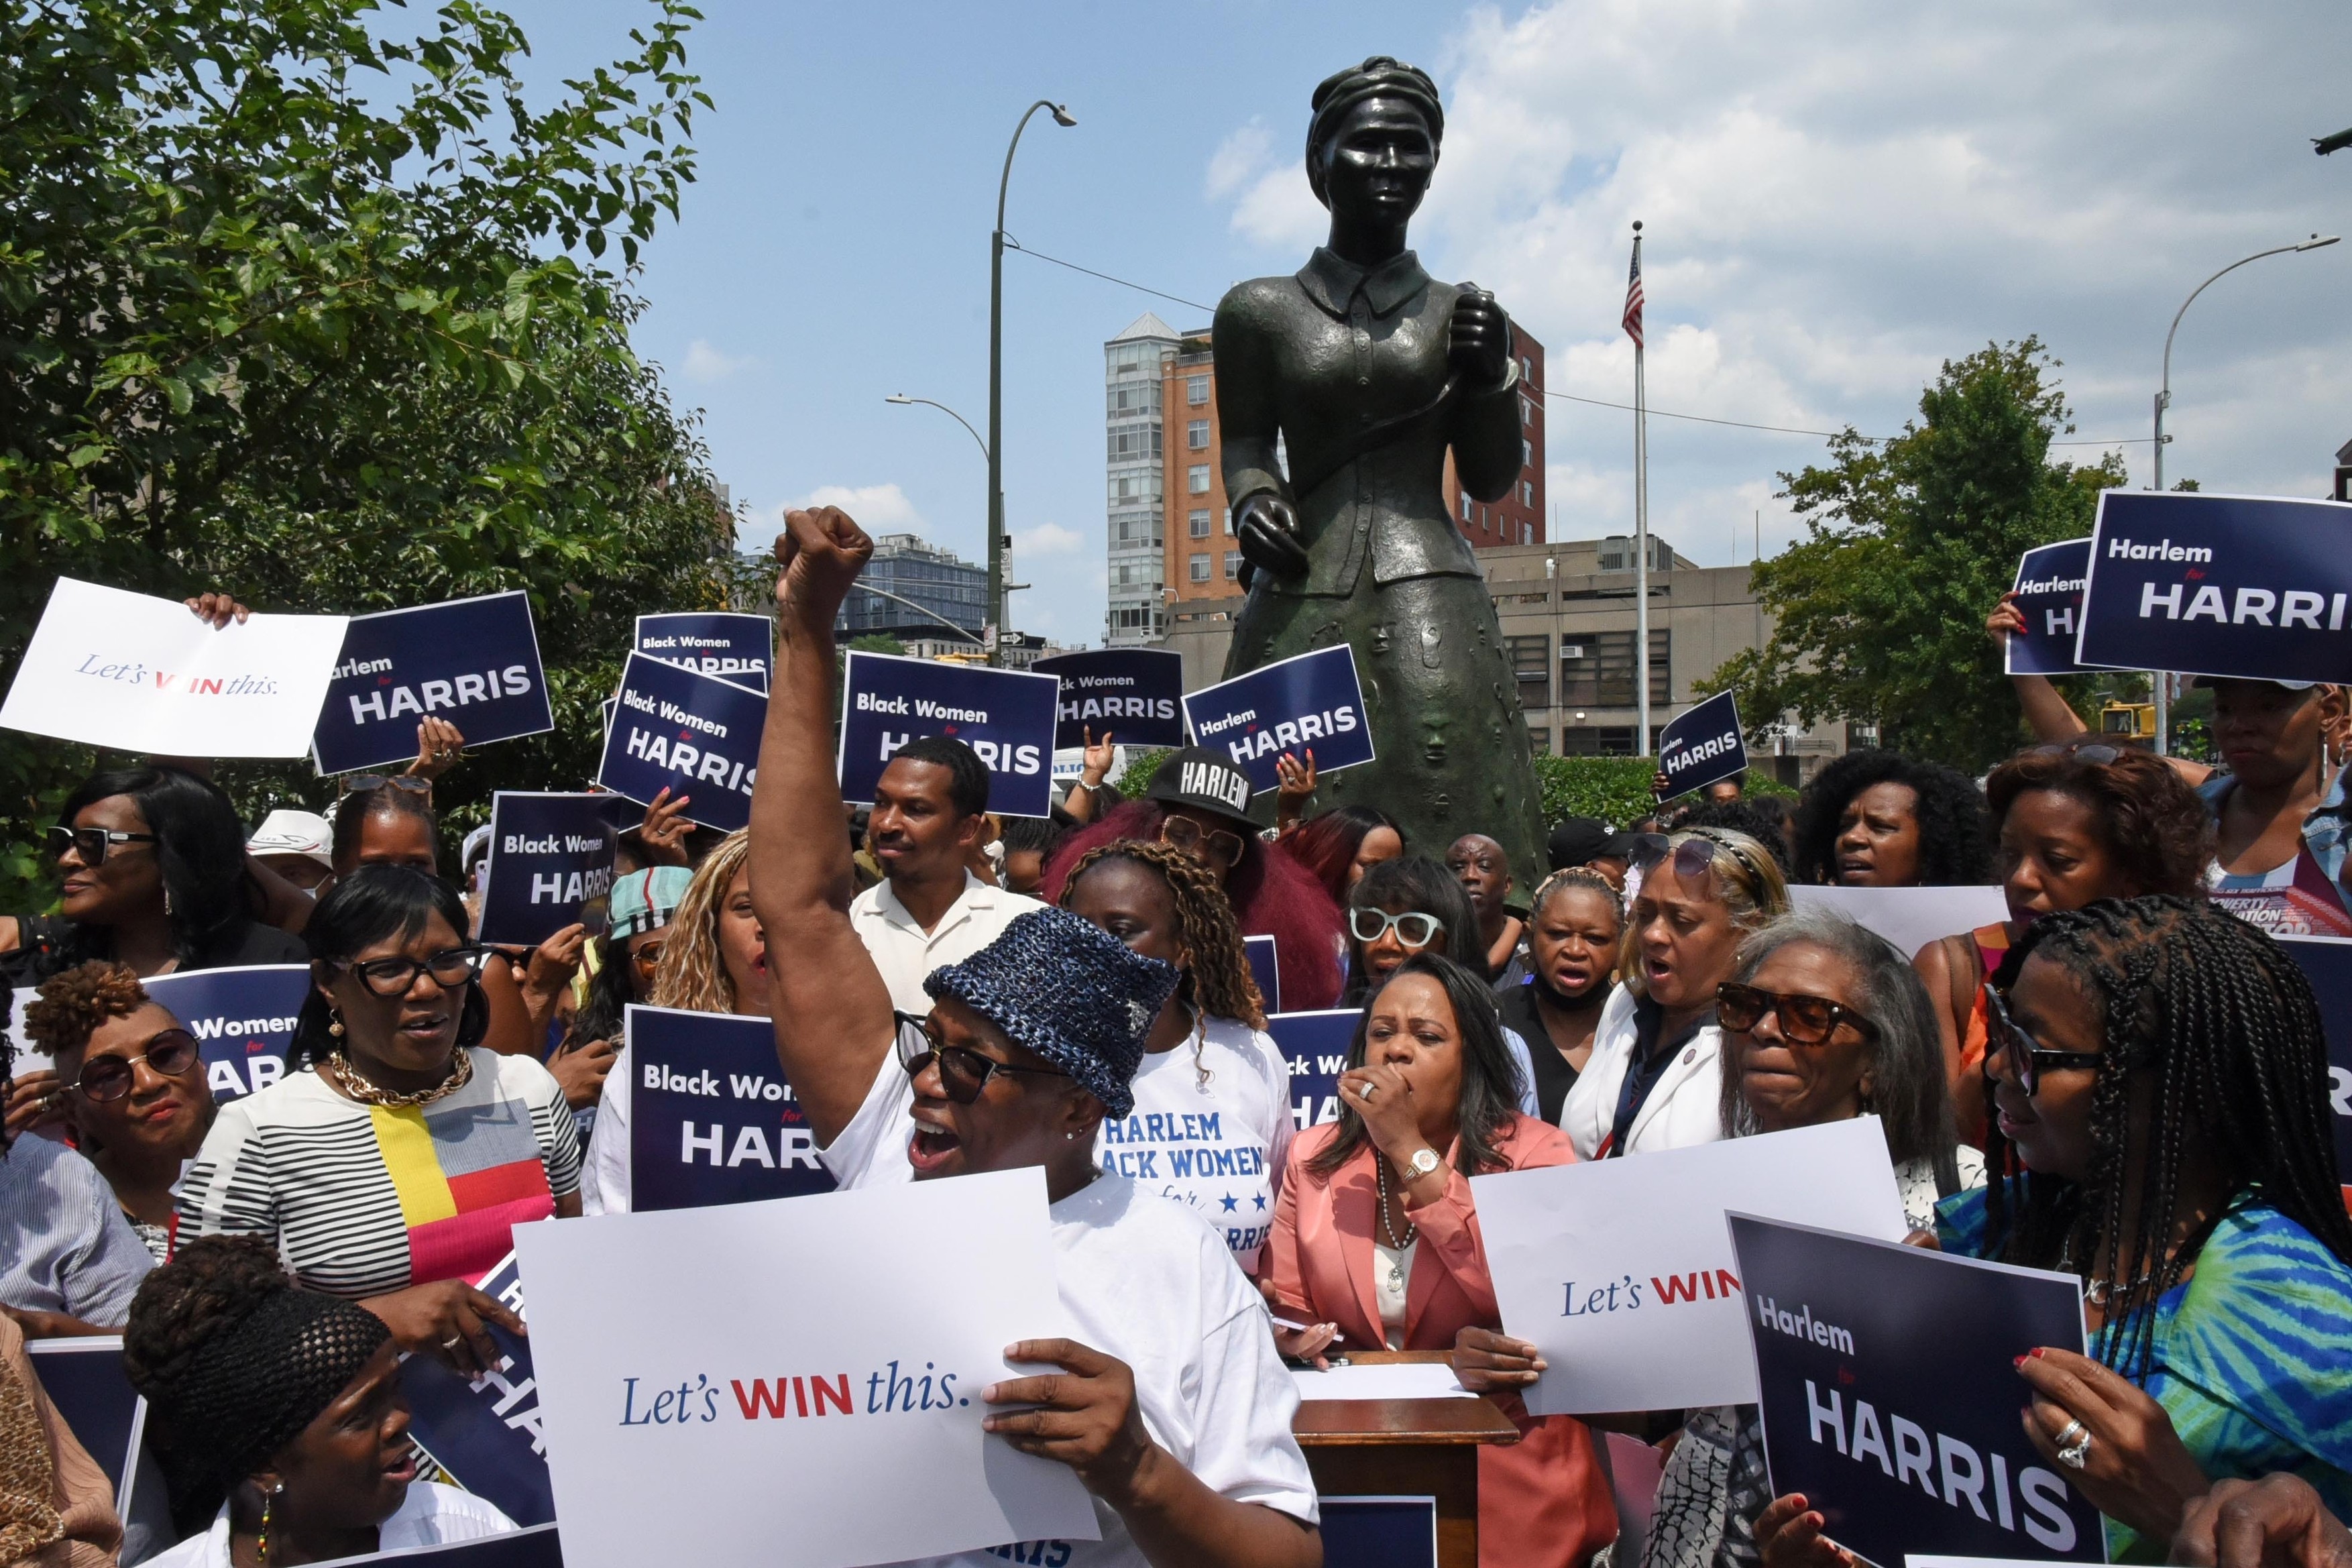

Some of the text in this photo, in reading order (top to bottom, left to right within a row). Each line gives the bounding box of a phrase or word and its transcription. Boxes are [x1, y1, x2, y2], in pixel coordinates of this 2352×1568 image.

[2109, 538, 2213, 563] Harlem
[2019, 575, 2086, 596] Harlem
[2185, 568, 2207, 581] for
[2139, 582, 2352, 631] HARRI
[642, 636, 730, 649] Black Women
[74, 653, 147, 684] Let's
[226, 675, 278, 695] this.
[331, 658, 393, 680] arlem
[1078, 676, 1135, 688] Women
[349, 665, 531, 725] HARRIS
[856, 693, 988, 724] Black Women
[1058, 697, 1175, 722] HARRIS
[623, 689, 728, 738] Black Women
[1199, 710, 1257, 737] Harlem
[1229, 706, 1357, 765] HARRIS
[879, 731, 1041, 775] HRIS
[1667, 732, 1737, 775] HARRIS
[1180, 762, 1249, 812] HARLEM
[504, 834, 603, 854] Black Women
[530, 865, 612, 904] HARRIS
[190, 1017, 299, 1040] Women
[245, 1040, 265, 1054] for
[644, 1064, 720, 1097] Black
[781, 1109, 803, 1123] for
[1105, 1112, 1223, 1144] HARLEM
[681, 1120, 823, 1170] HAR
[1102, 1146, 1264, 1179] ACK WOMEN
[1560, 1275, 1642, 1317] Let's
[1757, 1294, 1855, 1356] Harlem
[619, 1359, 970, 1426] Let's WIN this.
[1805, 1379, 2077, 1553] HARRIS
